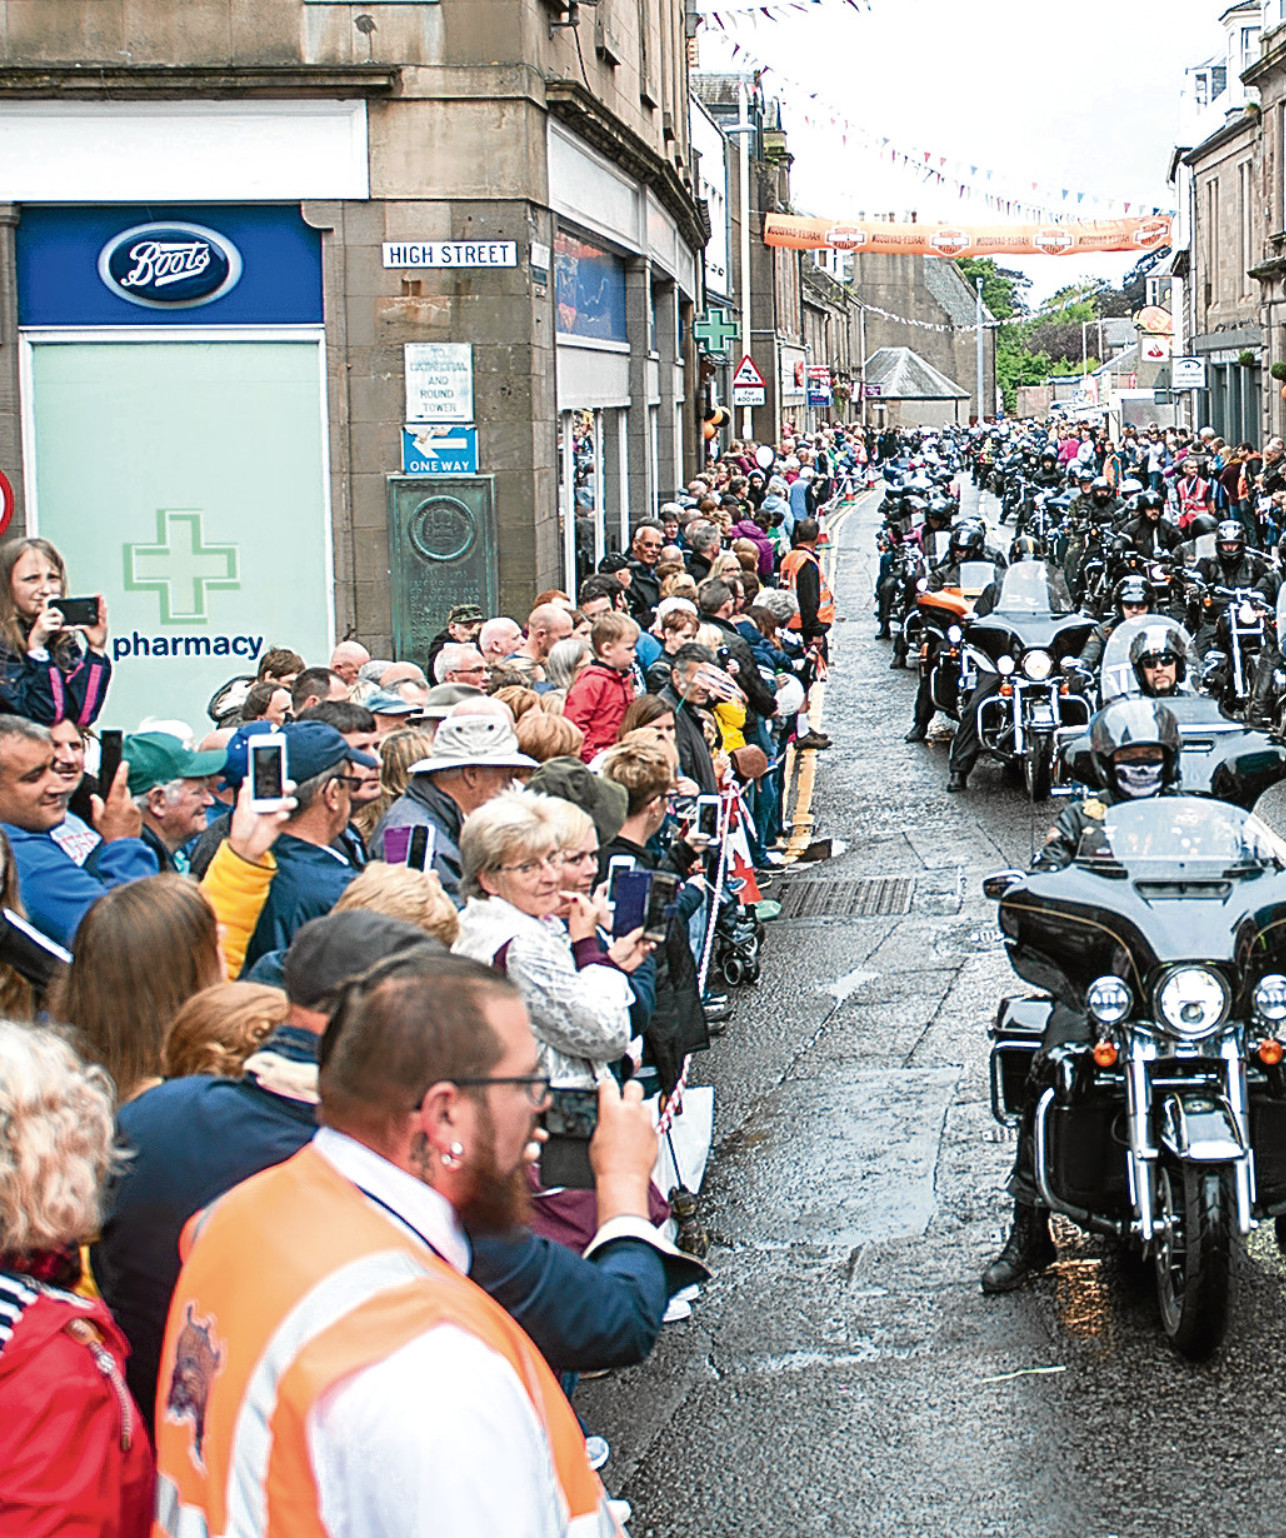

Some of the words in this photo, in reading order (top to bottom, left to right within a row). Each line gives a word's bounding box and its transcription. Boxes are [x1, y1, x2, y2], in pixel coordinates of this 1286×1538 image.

[390, 246, 433, 264] HIGH
[441, 245, 509, 264] STREET
[121, 241, 210, 287] Boots
[428, 376, 449, 385] AND
[420, 389, 454, 399] ROUND
[423, 403, 457, 412] TOWER
[410, 461, 438, 471] ONE
[441, 461, 469, 471] WAY
[113, 631, 263, 661] pharmacy
